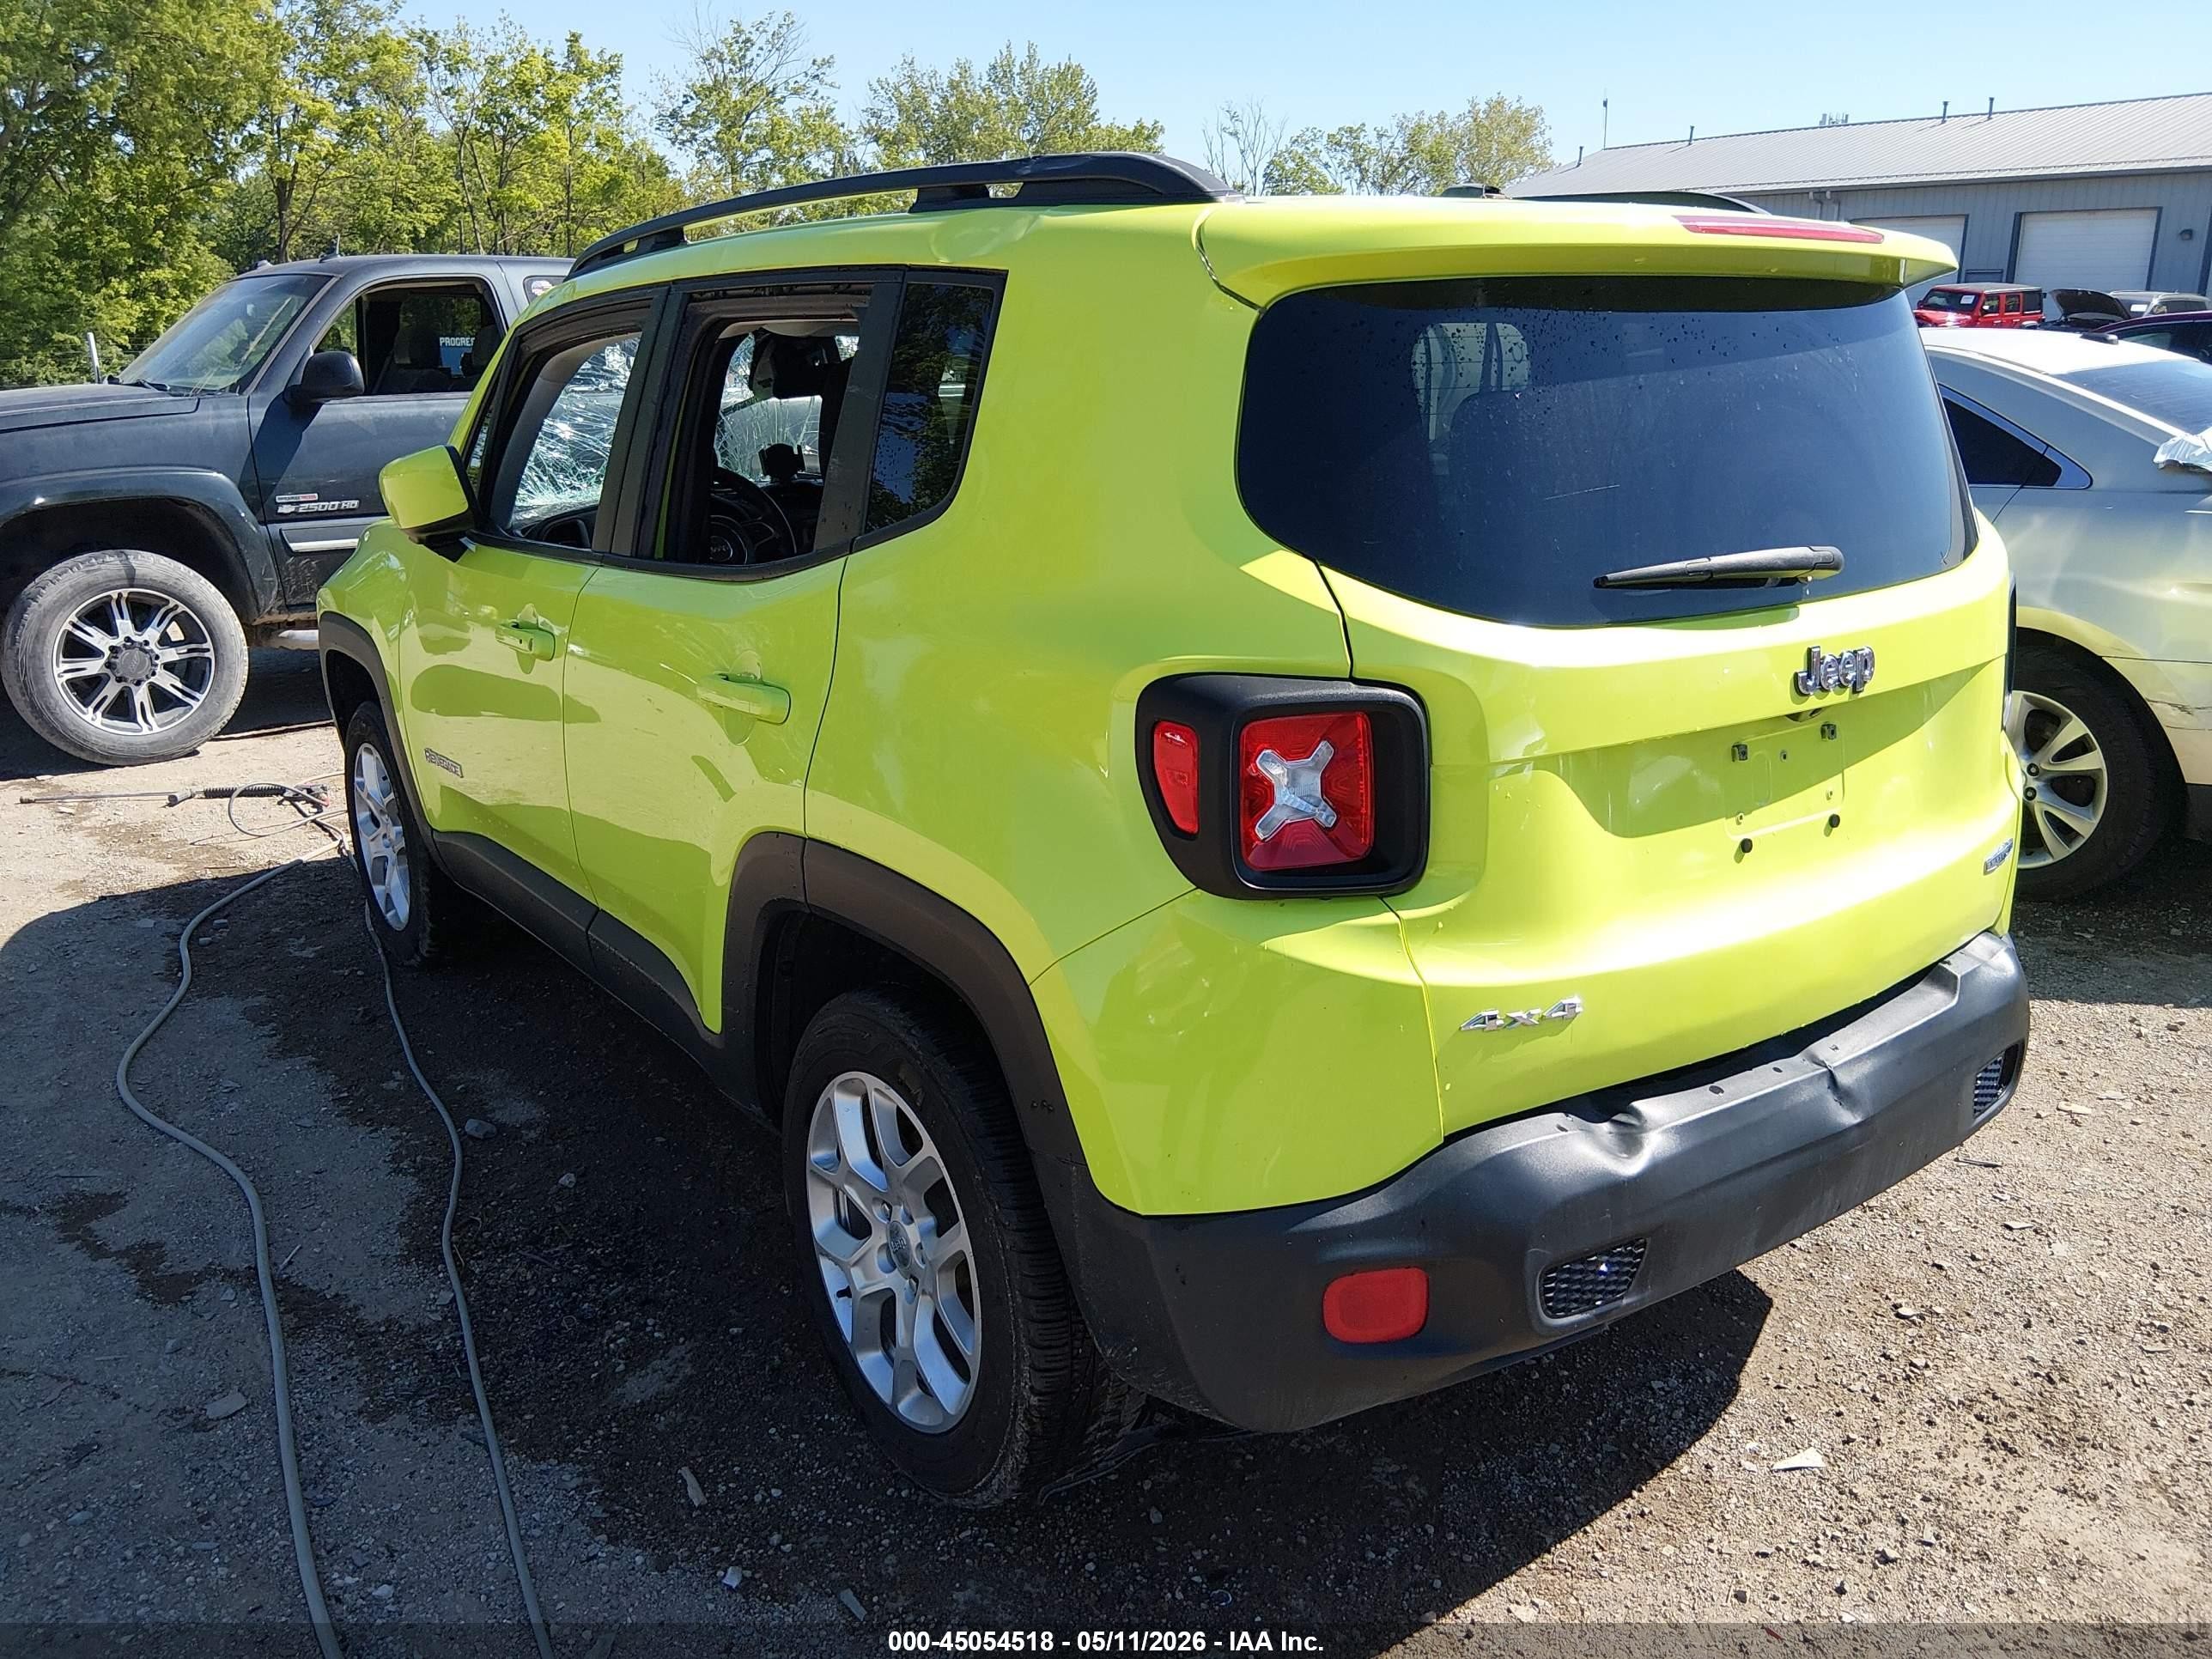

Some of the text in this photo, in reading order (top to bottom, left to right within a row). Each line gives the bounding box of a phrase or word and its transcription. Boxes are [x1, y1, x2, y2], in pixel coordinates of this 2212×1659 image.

[298, 500, 360, 513] 2500 HD
[1793, 646, 1875, 696] Jeep
